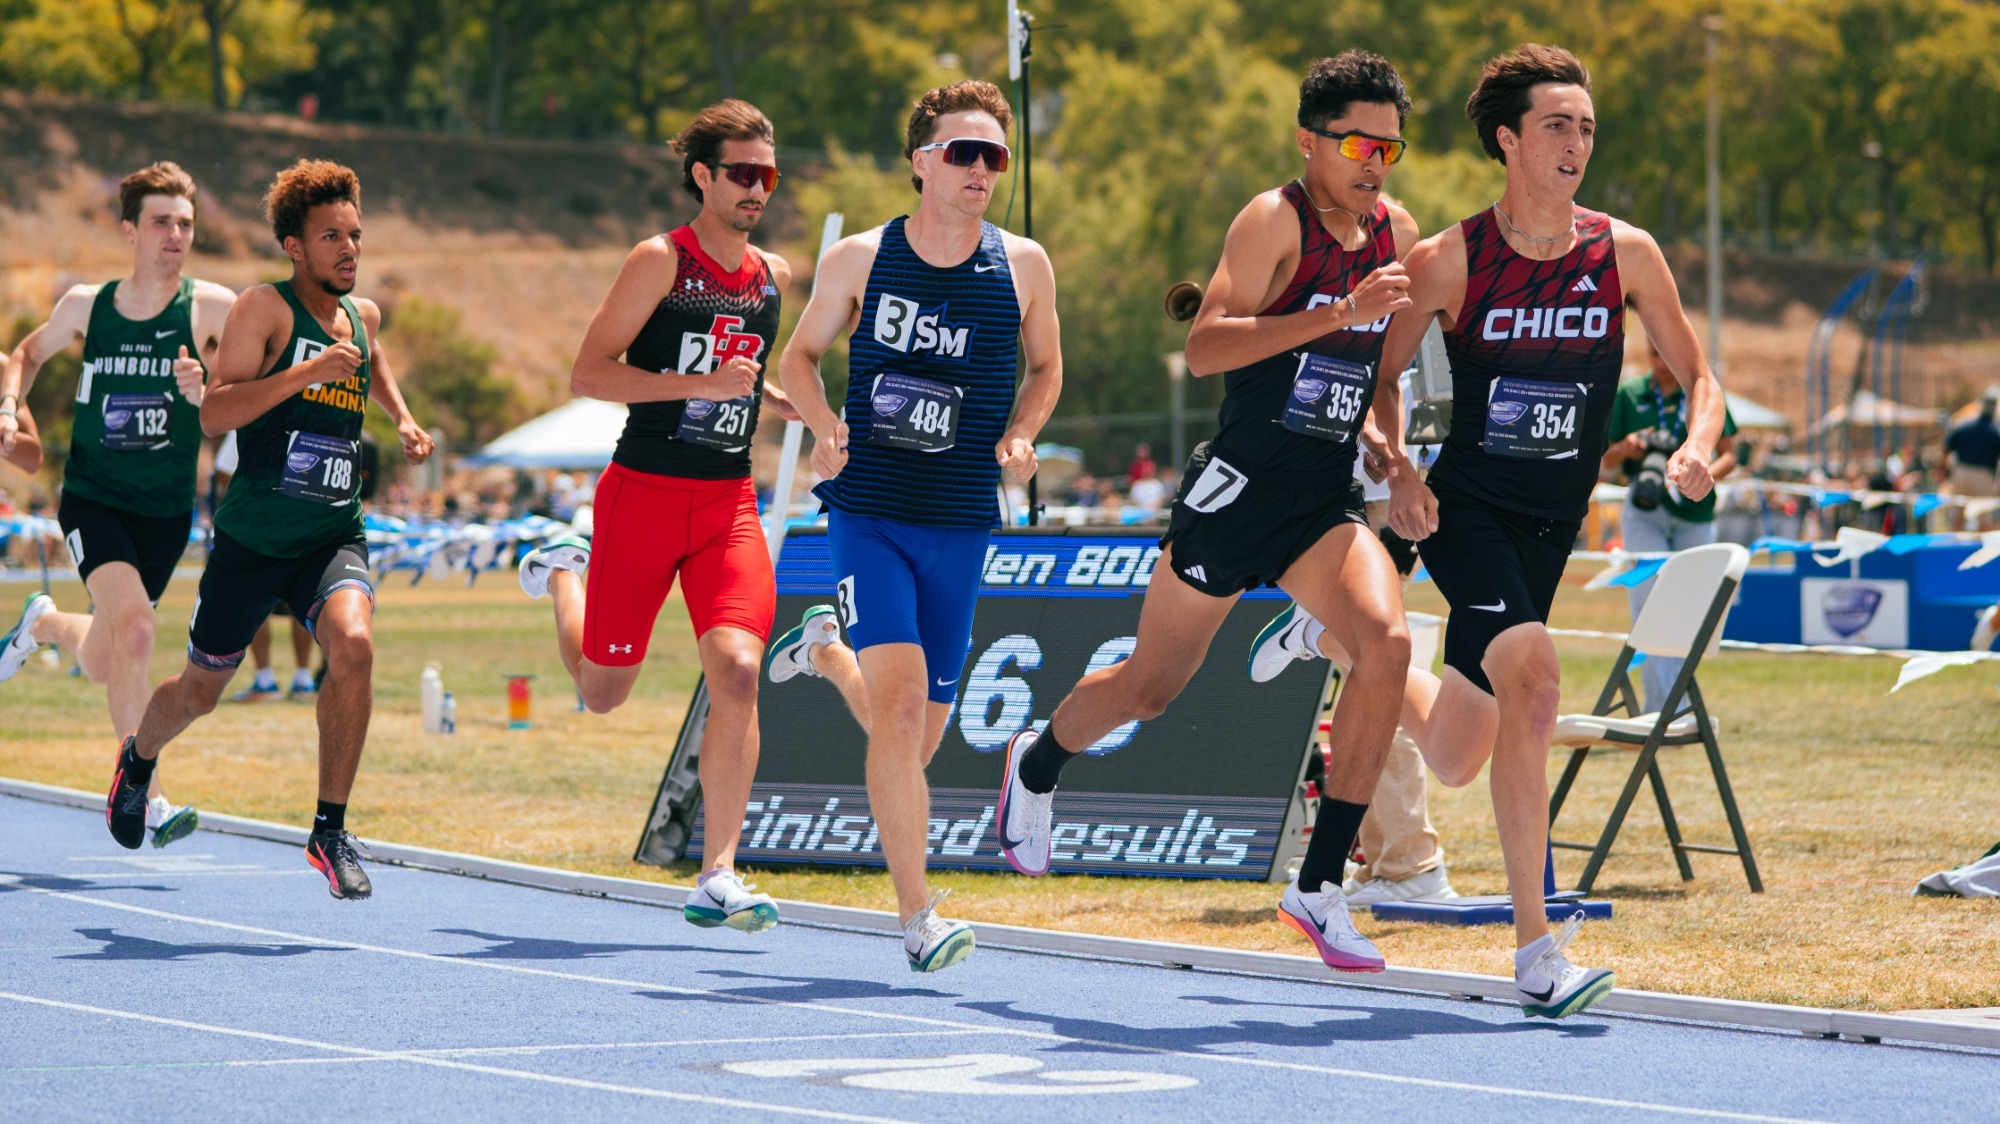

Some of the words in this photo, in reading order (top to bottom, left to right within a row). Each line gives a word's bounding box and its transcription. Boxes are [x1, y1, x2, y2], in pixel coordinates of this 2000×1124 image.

[881, 299, 908, 345] 3
[912, 314, 970, 358] SM
[1482, 306, 1609, 341] CHICO
[93, 356, 177, 377] HUMBOLD
[120, 344, 134, 352] CAL
[135, 344, 153, 353] POLY
[685, 336, 707, 375] 2
[714, 402, 749, 436] 251
[908, 398, 951, 438] 484
[1326, 382, 1364, 422] 355
[1531, 403, 1576, 439] 354
[135, 408, 168, 436] 132
[322, 456, 353, 491] 188
[1197, 464, 1239, 510] 7
[982, 544, 1057, 585] en
[839, 582, 850, 625] 3
[998, 809, 1258, 866] esults
